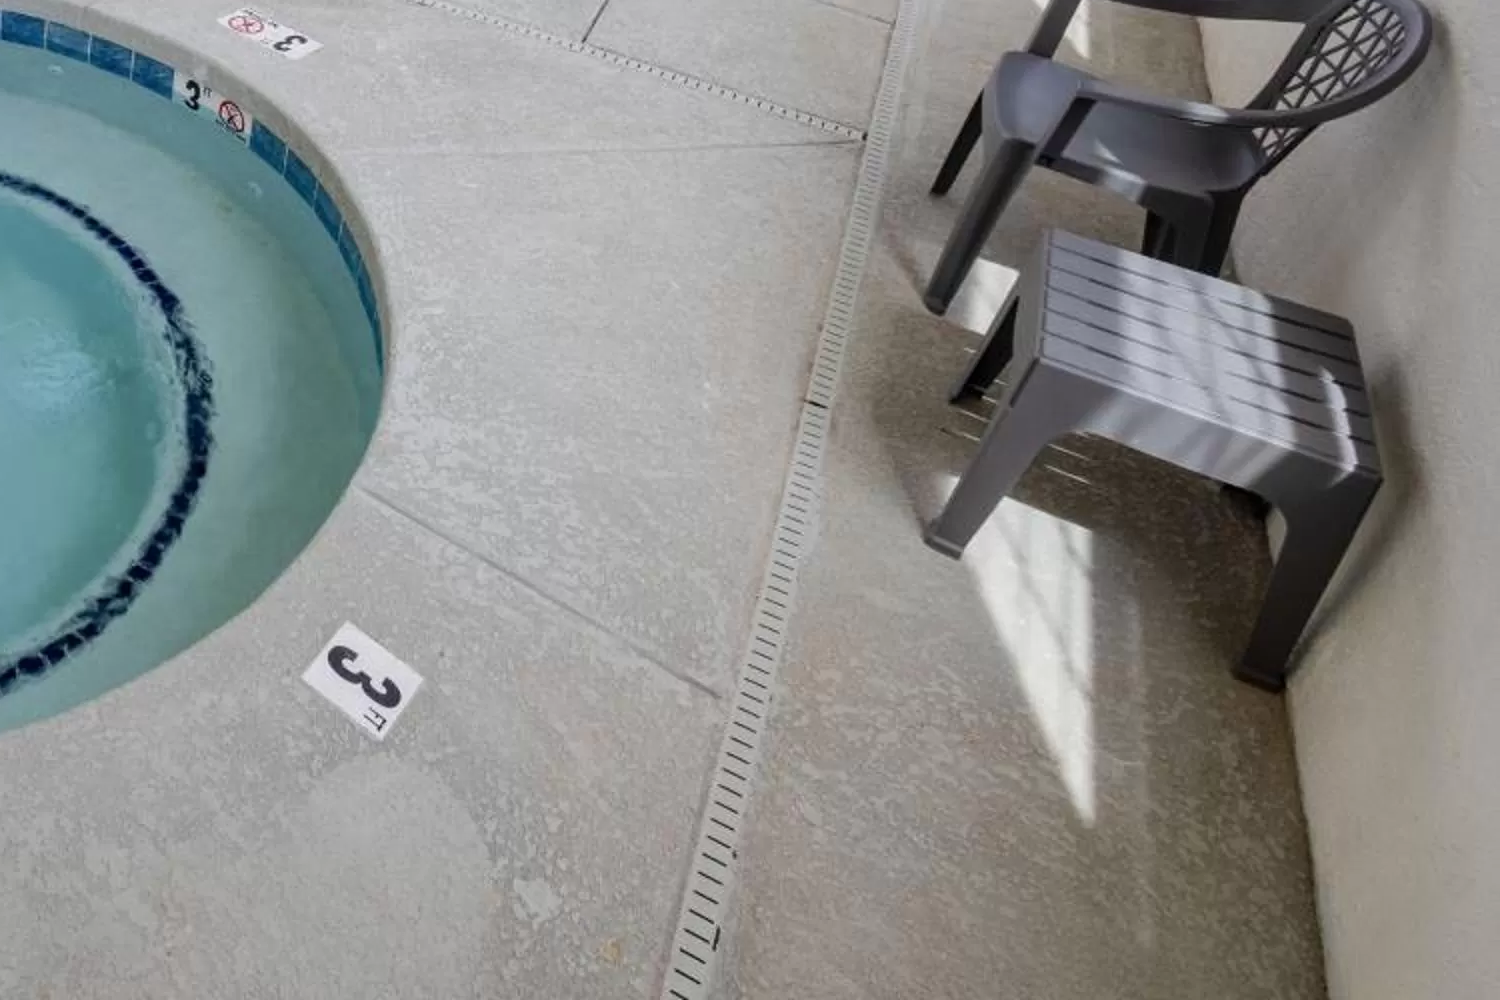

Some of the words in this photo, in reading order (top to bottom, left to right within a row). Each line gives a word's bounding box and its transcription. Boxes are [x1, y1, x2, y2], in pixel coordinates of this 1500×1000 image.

[273, 34, 308, 52] 3
[184, 79, 201, 111] 3
[327, 645, 402, 708] 3
